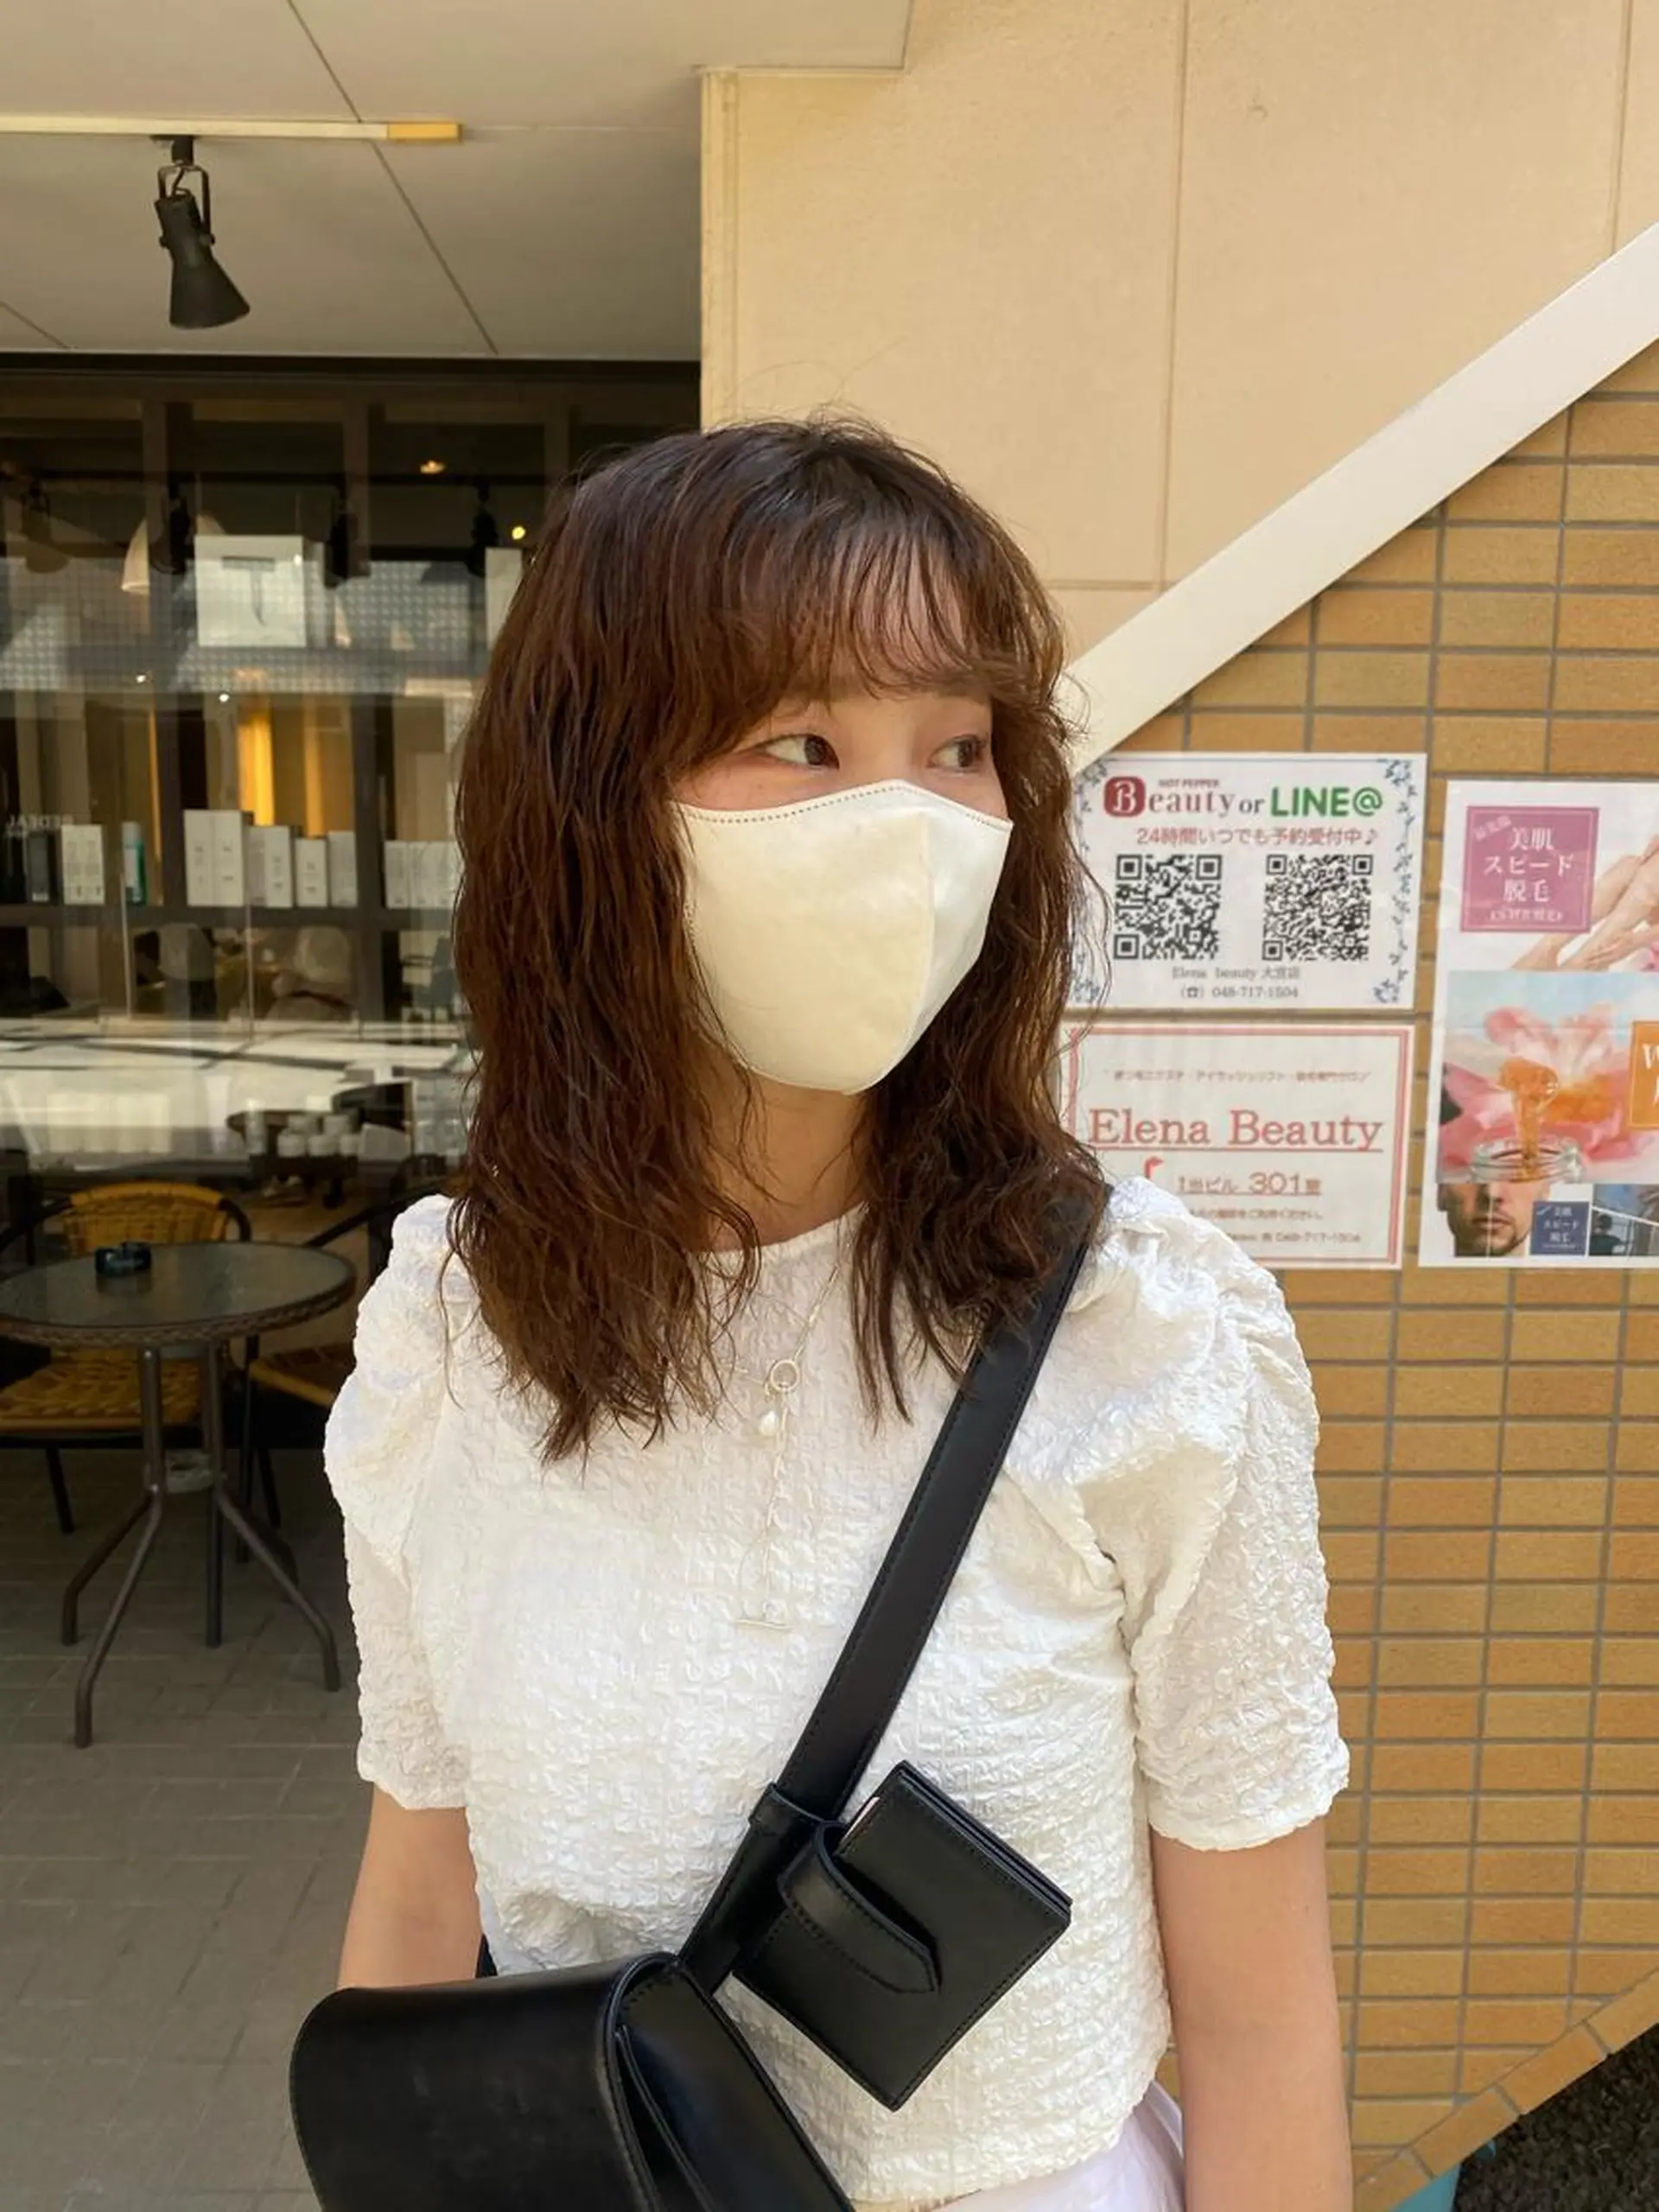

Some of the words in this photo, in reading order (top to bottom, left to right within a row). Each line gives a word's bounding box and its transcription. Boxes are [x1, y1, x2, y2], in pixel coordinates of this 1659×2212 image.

[1104, 776, 1236, 818] Beauty
[1239, 798, 1265, 814] or
[1270, 786, 1382, 817] LINE@
[1510, 827, 1555, 851] 美肌
[1483, 854, 1575, 880] スピード
[1502, 879, 1552, 904] 脱毛
[1089, 1108, 1211, 1146] Elena
[1229, 1109, 1385, 1153] Beauty
